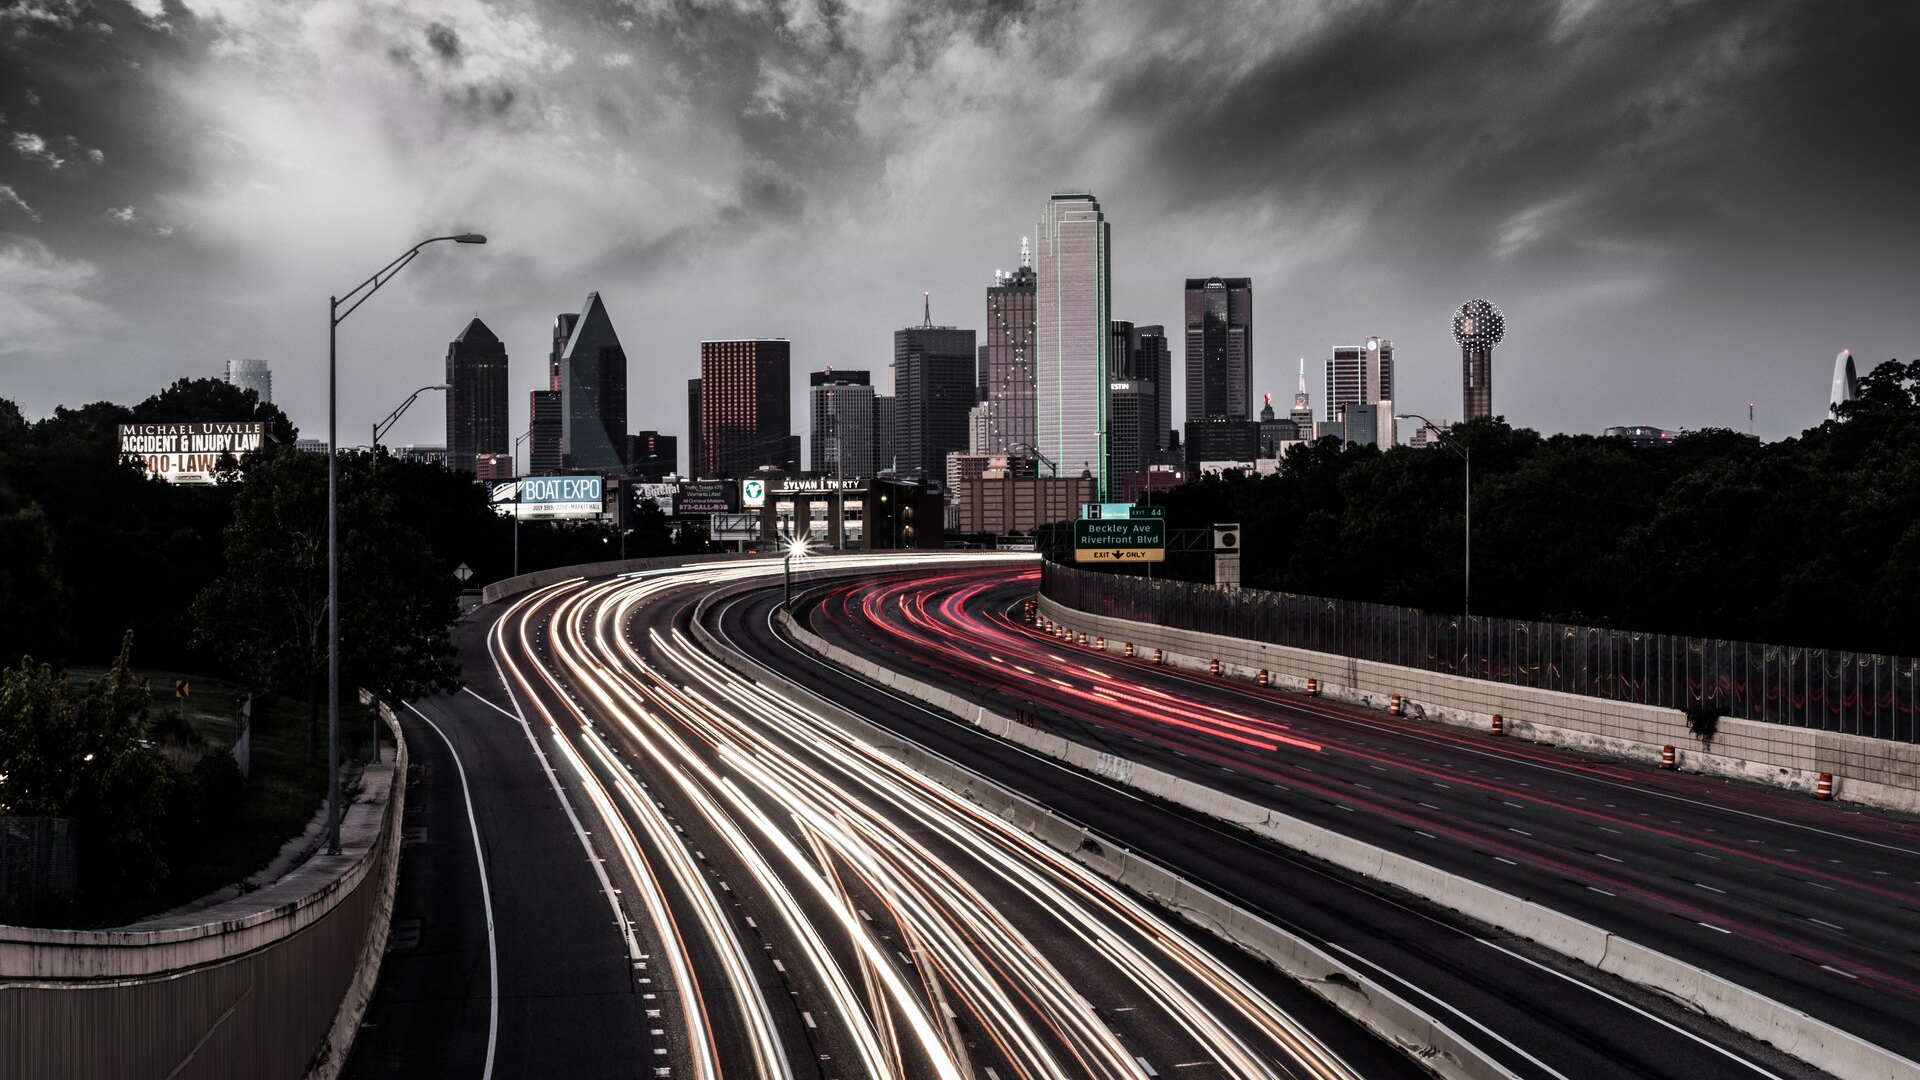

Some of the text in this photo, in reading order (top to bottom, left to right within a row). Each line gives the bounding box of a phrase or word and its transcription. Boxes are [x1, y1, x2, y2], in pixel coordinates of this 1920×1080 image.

[123, 423, 260, 435] MICHAEL UVALLE
[122, 433, 260, 453] ACCIDENT & INJURY LAW
[526, 478, 600, 500] BOAT EXPO
[783, 481, 817, 490] SYLVAN
[826, 480, 860, 490] THRTY
[1089, 505, 1100, 518] H
[1089, 524, 1151, 534] Beckley Ave
[1081, 535, 1159, 543] Riverfront Blvd
